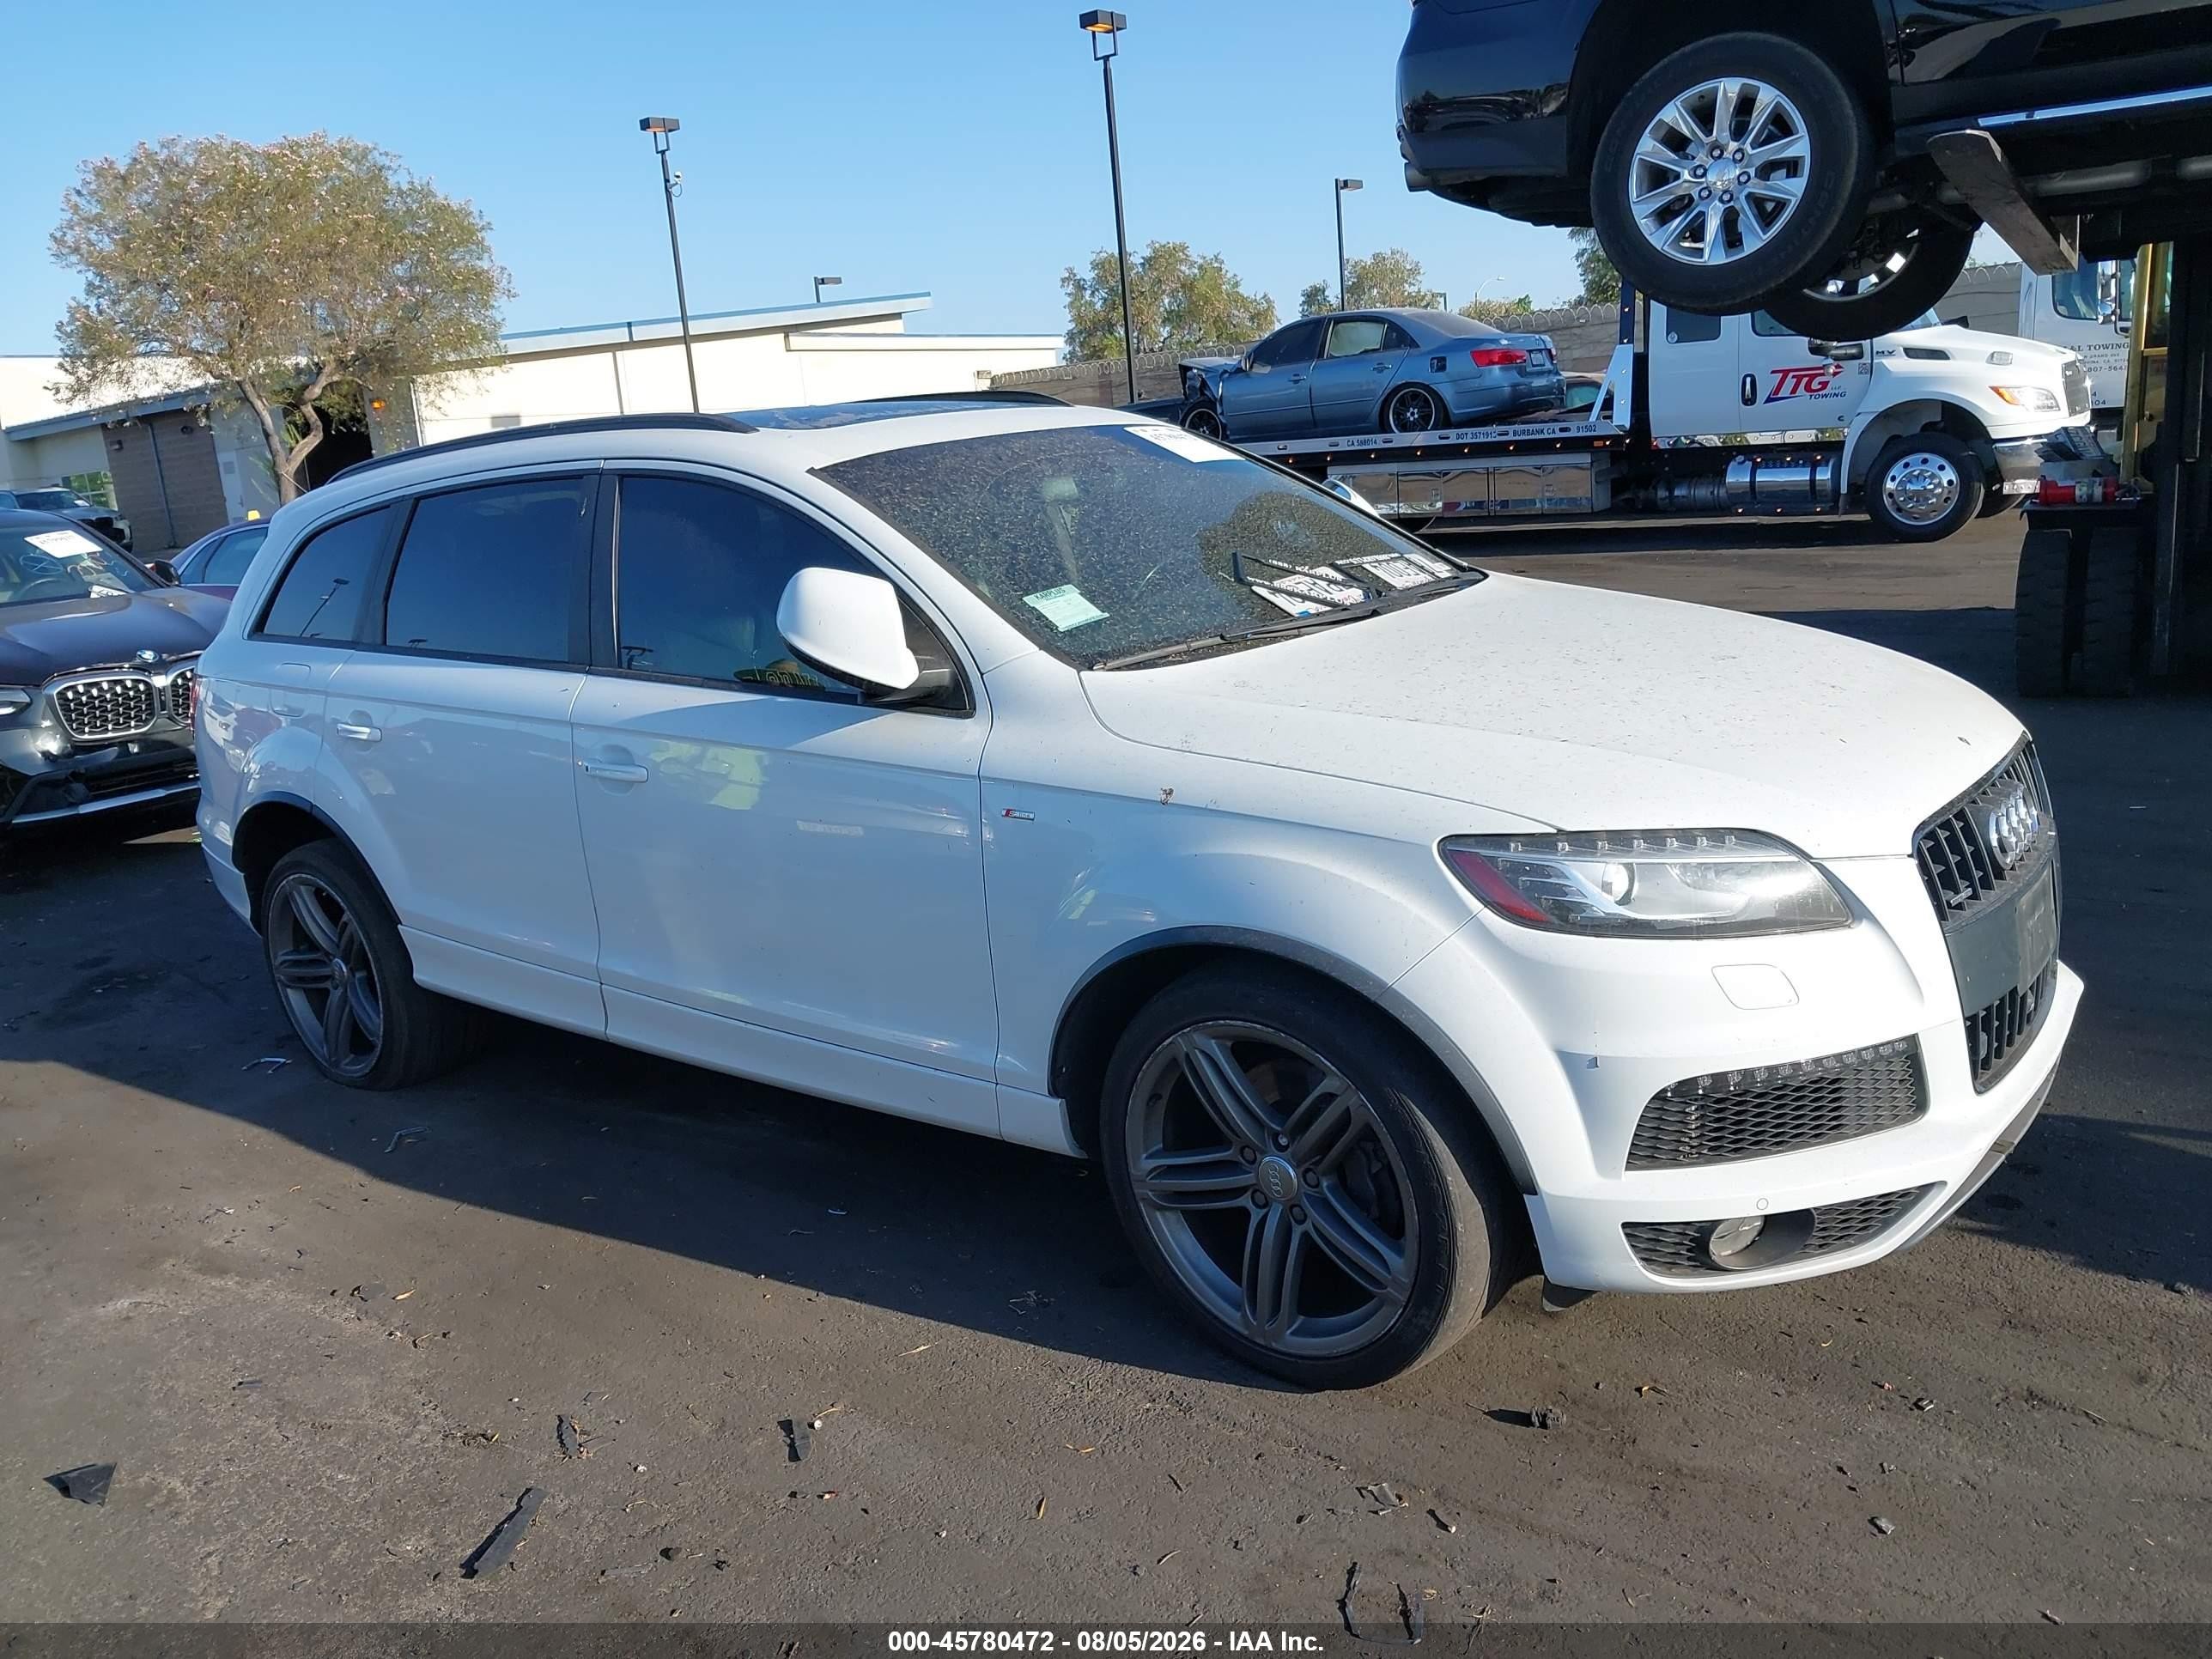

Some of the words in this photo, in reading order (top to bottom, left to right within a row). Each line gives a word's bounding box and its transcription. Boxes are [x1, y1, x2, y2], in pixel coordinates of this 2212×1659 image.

[2087, 343, 2130, 351] TOWING
[1808, 390, 1847, 400] TOWING
[1576, 424, 1597, 434] 91502
